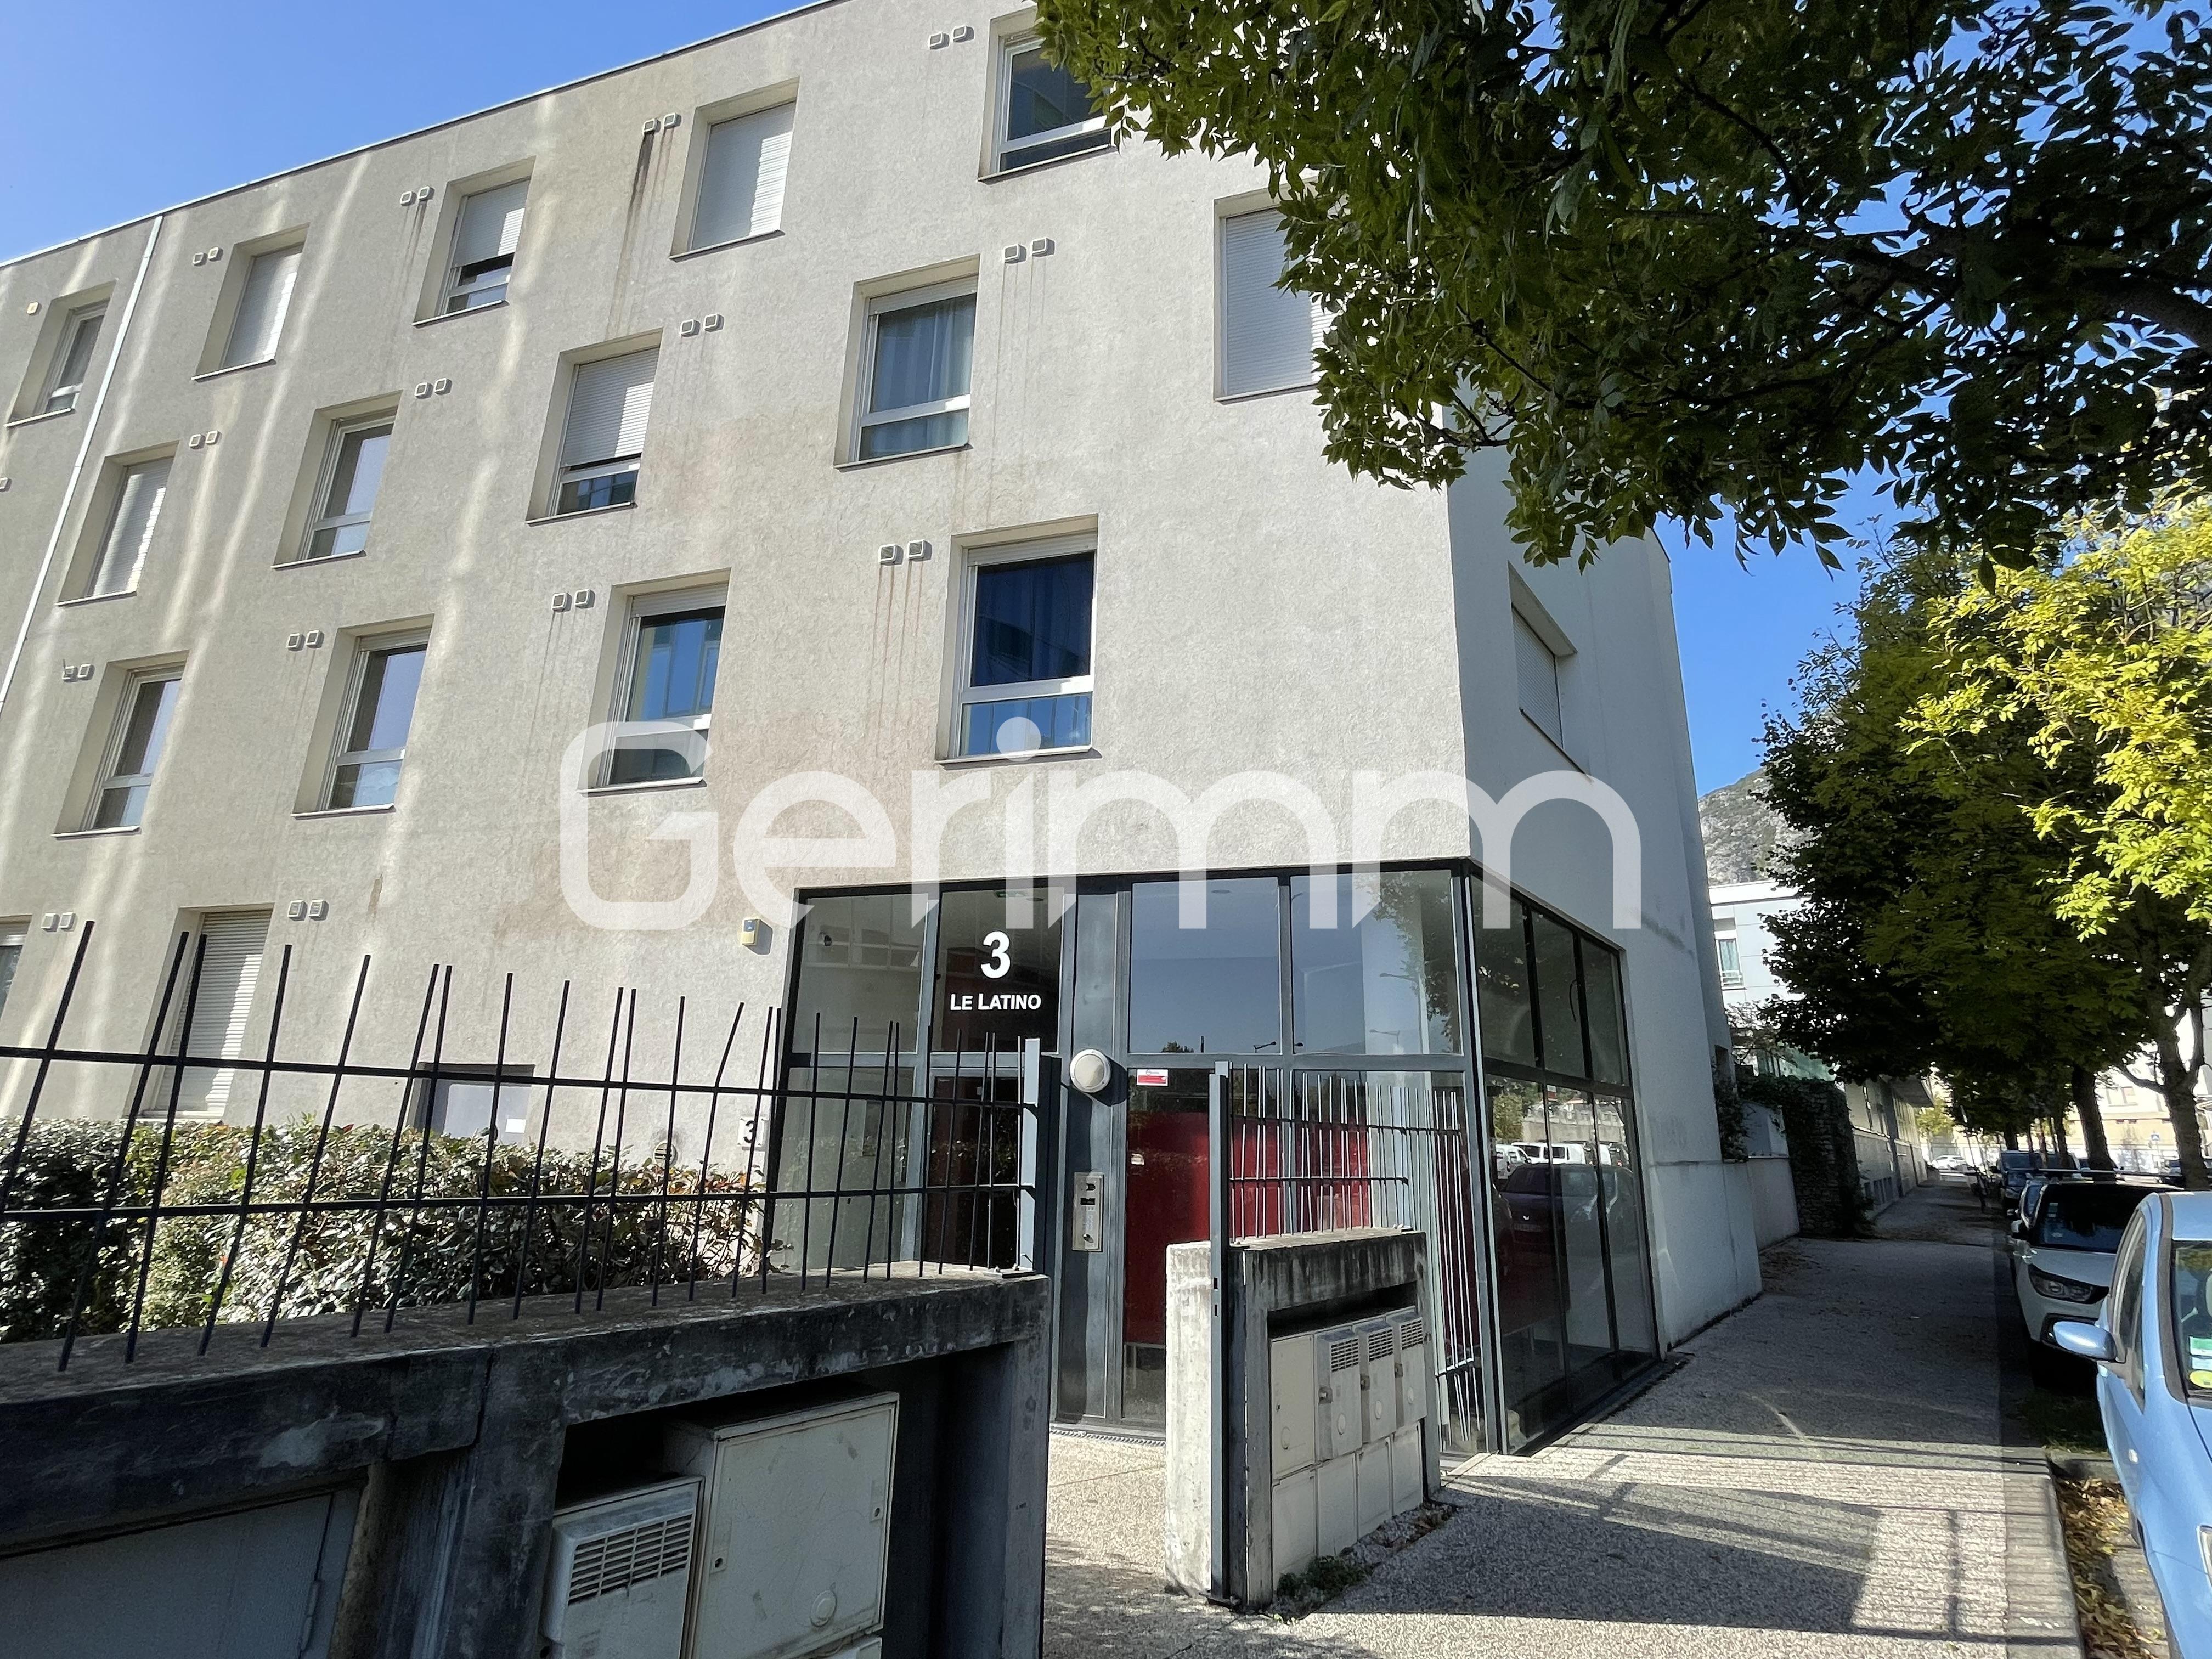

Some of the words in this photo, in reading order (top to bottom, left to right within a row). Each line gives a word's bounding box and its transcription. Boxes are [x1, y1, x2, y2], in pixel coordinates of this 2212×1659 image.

[980, 930, 1011, 979] 3
[950, 993, 973, 1011] LE
[978, 992, 1041, 1011] LATINO
[743, 1120, 757, 1143] 3
